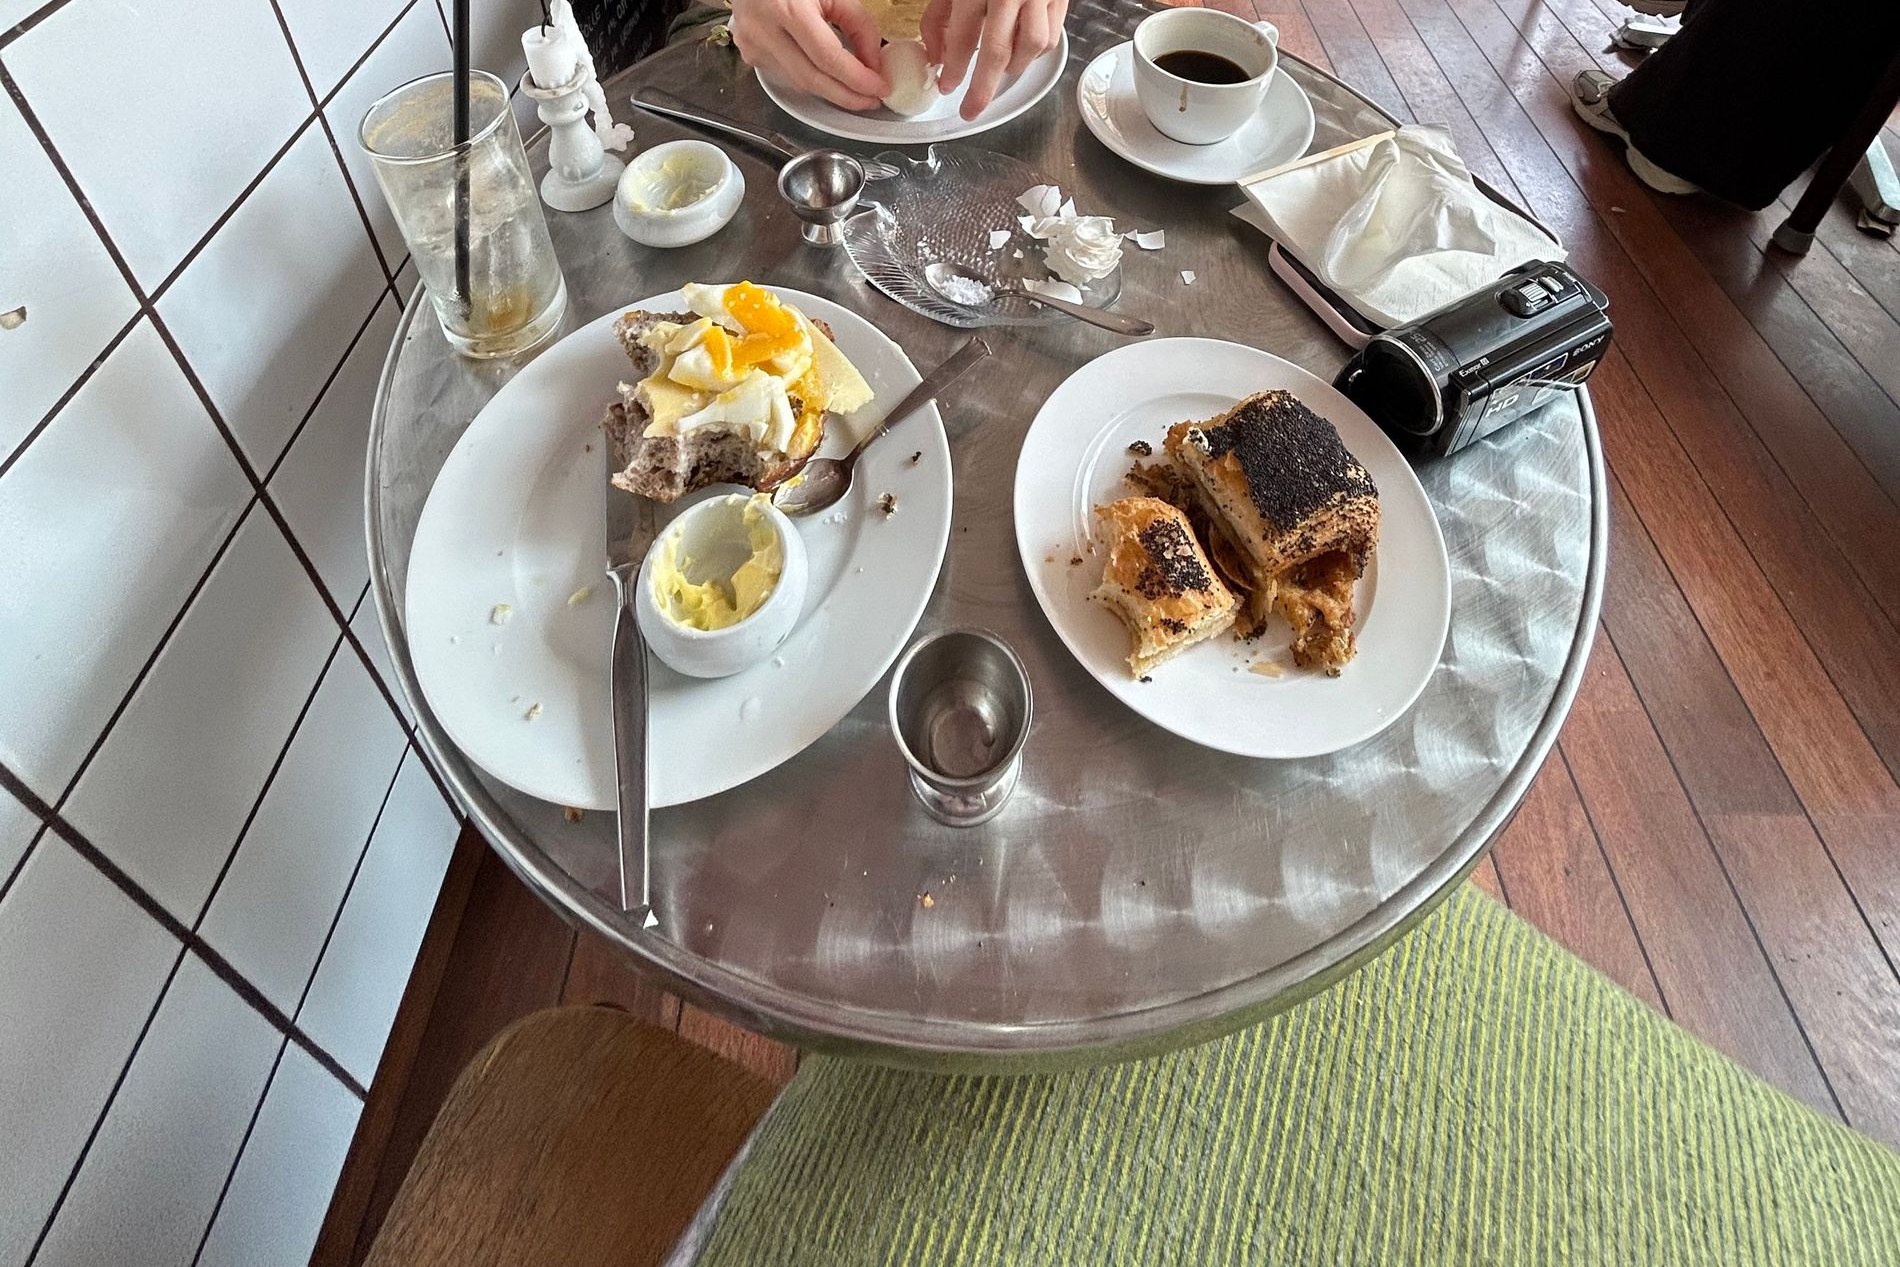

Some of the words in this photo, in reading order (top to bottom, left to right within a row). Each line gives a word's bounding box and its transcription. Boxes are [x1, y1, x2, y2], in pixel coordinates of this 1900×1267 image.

[1573, 334, 1605, 357] SONY
[1459, 362, 1482, 378] Exmor
[1485, 394, 1520, 418] HD
